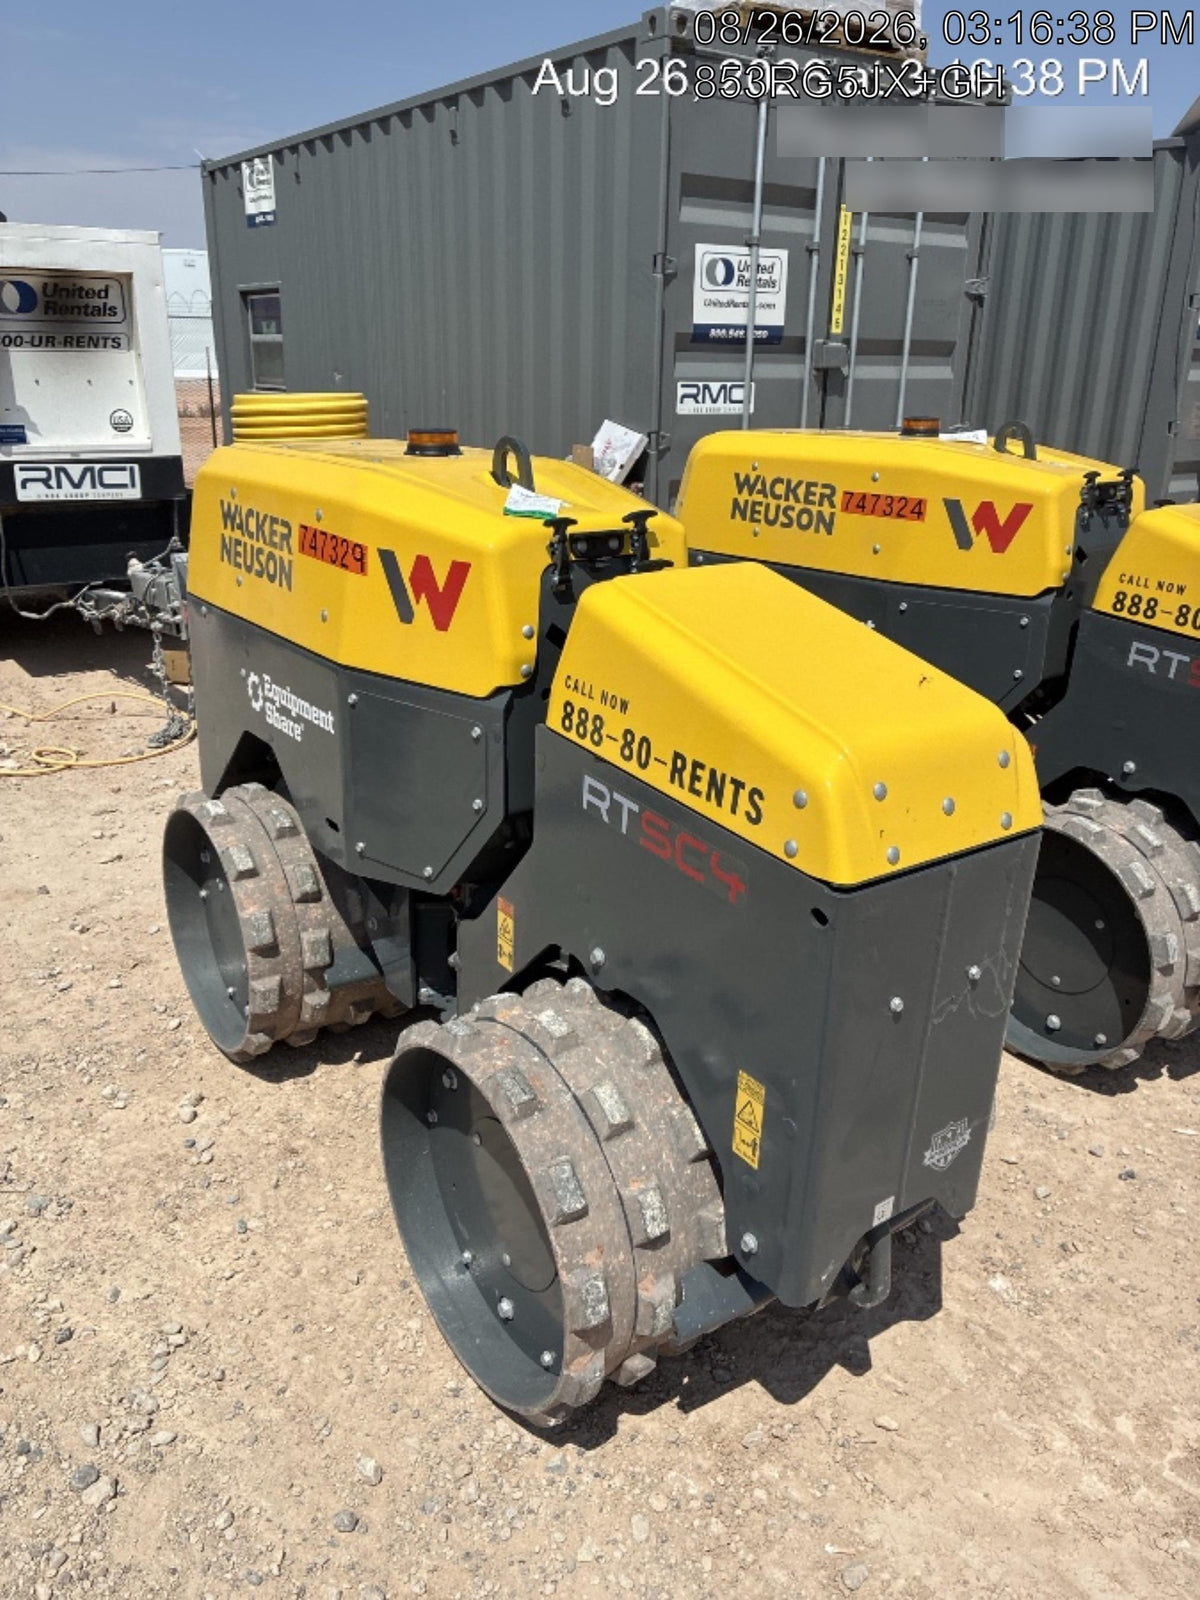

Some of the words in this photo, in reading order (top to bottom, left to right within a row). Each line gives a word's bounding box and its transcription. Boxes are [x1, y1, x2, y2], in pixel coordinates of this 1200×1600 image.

[736, 273, 777, 288] Retals
[737, 259, 775, 274] Unted
[42, 282, 109, 300] United
[44, 301, 118, 317] Rentals
[0, 335, 122, 349] 00-UR-RENTS
[680, 383, 745, 404] RMC
[19, 465, 136, 489] RMCI
[734, 472, 837, 509] WACKER
[730, 497, 836, 536] NEUSON
[844, 491, 924, 521] 747324
[220, 498, 293, 555] WACKER
[220, 533, 293, 592] NEUSON
[300, 525, 365, 574] 747329
[1118, 573, 1149, 589] CALL
[1156, 580, 1187, 596] NOW
[262, 673, 335, 735] Equipment
[564, 674, 595, 700] CALL
[600, 689, 630, 715] NOW
[265, 701, 302, 742] Share
[561, 700, 765, 826] 888-80-RENTS
